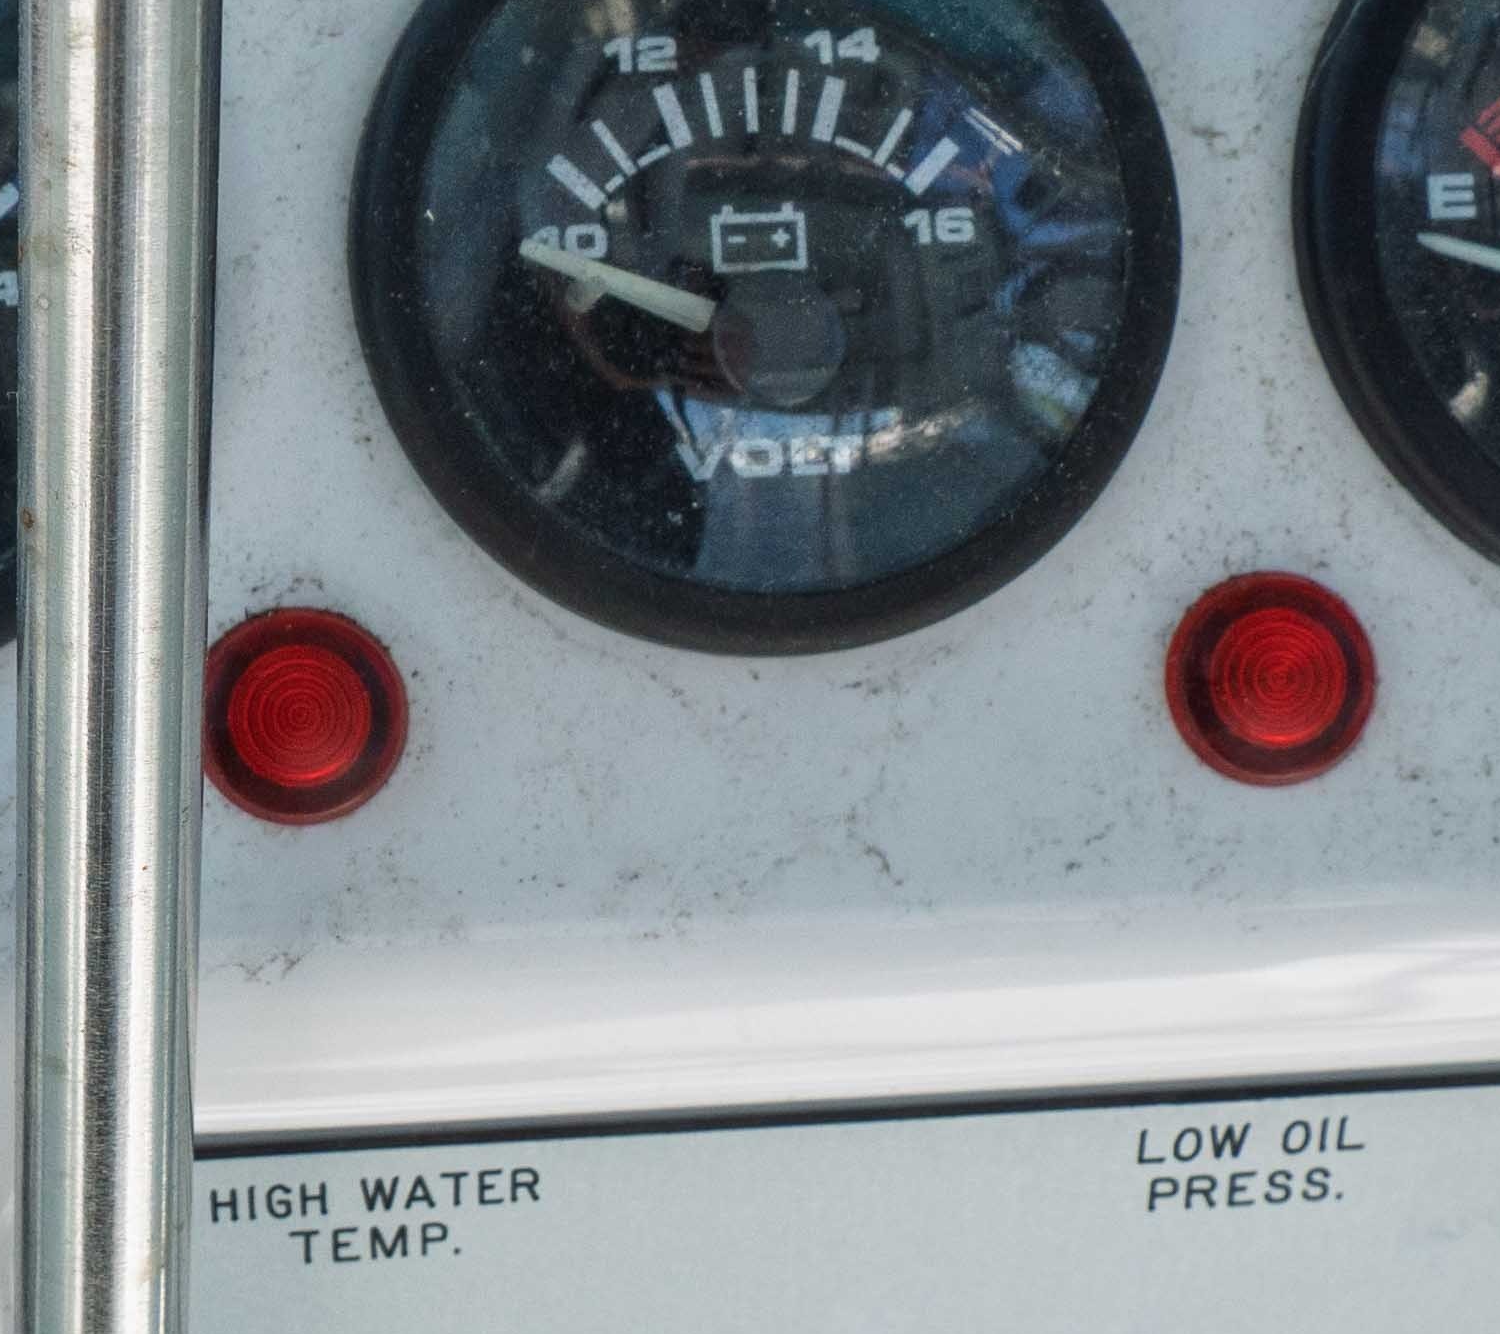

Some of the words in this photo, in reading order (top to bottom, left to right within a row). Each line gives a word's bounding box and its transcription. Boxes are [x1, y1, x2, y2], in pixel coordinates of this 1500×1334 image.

[603, 35, 678, 73] 12
[804, 26, 882, 66] 14
[1427, 173, 1477, 222] E
[904, 207, 977, 246] 16
[675, 432, 866, 481] VOLT
[1137, 1121, 1251, 1166] LOW
[1281, 1115, 1366, 1154] OIL
[210, 1181, 330, 1223] HIGH
[361, 1167, 542, 1212] WATER
[1146, 1167, 1344, 1213] PRESS.
[289, 1222, 463, 1266] TEMP.
